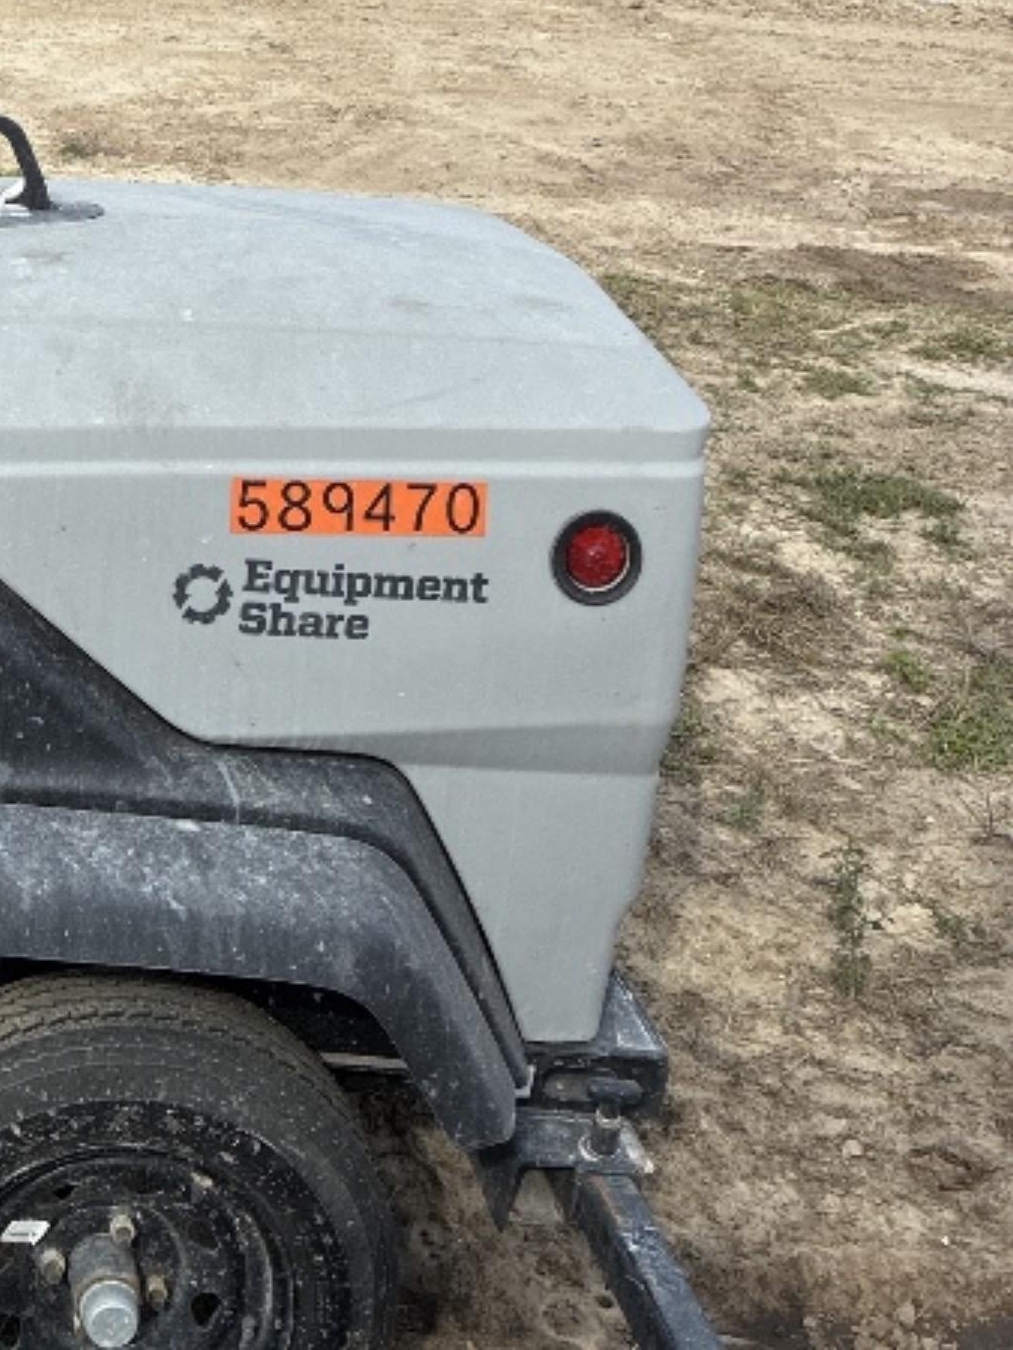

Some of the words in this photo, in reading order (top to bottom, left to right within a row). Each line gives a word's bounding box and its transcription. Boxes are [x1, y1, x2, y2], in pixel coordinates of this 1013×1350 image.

[237, 479, 481, 534] 589470
[242, 558, 489, 605] Equipment
[238, 603, 370, 640] Share
